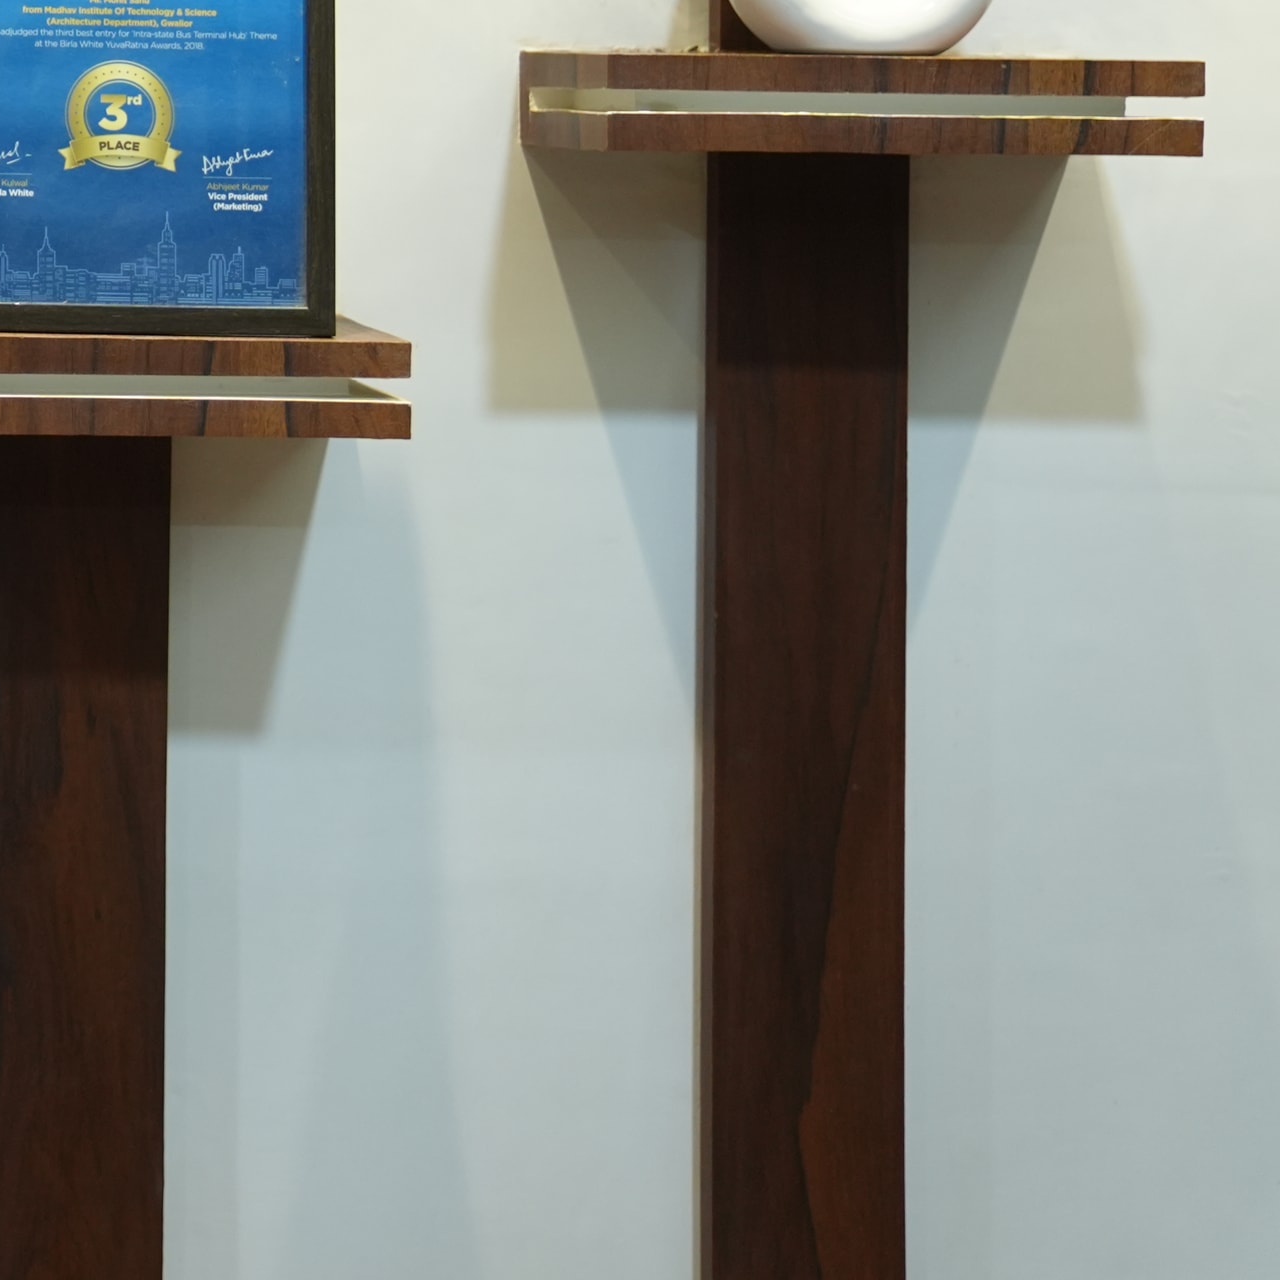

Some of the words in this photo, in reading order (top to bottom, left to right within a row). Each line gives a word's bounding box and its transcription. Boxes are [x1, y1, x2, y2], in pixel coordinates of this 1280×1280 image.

[45, 6, 76, 14] Madhav
[79, 6, 112, 14] Institute
[128, 7, 175, 17] Technology
[176, 8, 182, 16] &
[185, 8, 217, 16] Science
[47, 18, 101, 26] (Architecture
[104, 18, 159, 28] Department),
[0, 28, 38, 37] adjudged
[41, 28, 53, 36] the
[55, 28, 74, 36] third
[76, 29, 93, 37] best
[95, 30, 116, 38] entry
[118, 29, 129, 37] for
[194, 31, 227, 39] Terminal
[250, 32, 277, 40] Theme
[45, 39, 58, 47] the
[80, 40, 103, 48] White
[106, 41, 148, 49] YuvaRatna
[98, 93, 142, 131] 3rd
[99, 140, 140, 153] PLACE
[207, 183, 240, 191] Abhijeet
[9, 189, 34, 197] White
[208, 192, 226, 200] Vice
[228, 193, 268, 201] President
[213, 202, 262, 212] (Marketing)
